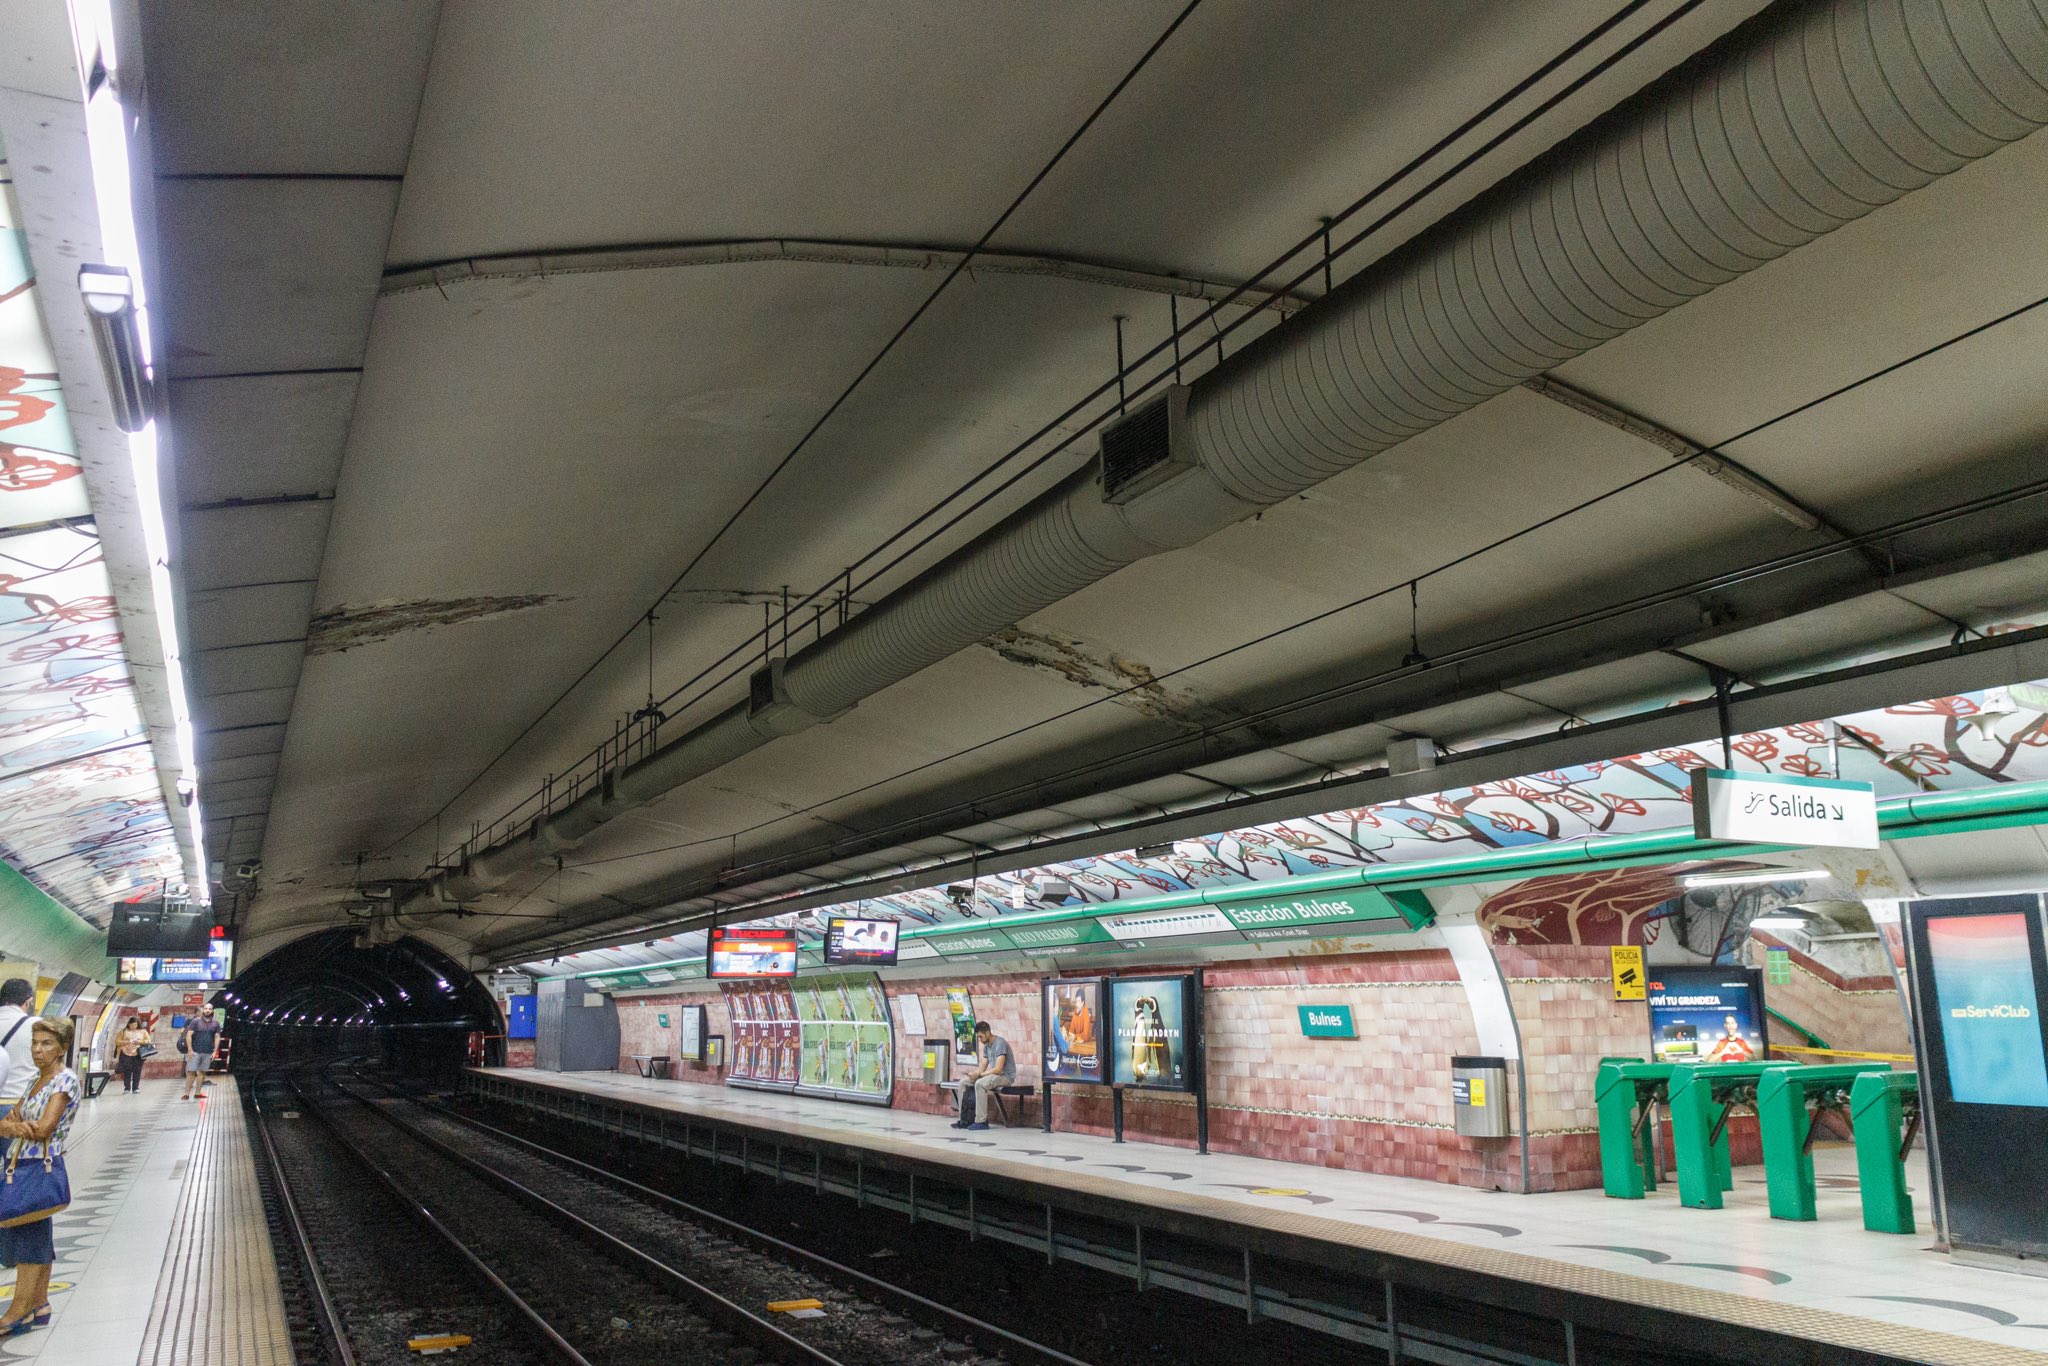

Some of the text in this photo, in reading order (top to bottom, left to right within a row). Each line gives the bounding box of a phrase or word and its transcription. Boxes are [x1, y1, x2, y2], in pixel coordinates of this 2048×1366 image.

[1769, 794, 1827, 820] Salida
[1228, 899, 1355, 924] Estación Bulnes
[1011, 926, 1079, 943] ALTO PALERMO
[964, 937, 996, 950] Bulnes
[1649, 981, 1666, 990] TCL
[1666, 996, 1677, 1005] TU
[1678, 996, 1721, 1006] GRANDEZA
[1966, 1004, 2031, 1018] ServiClub
[1308, 1011, 1343, 1027] Bulnes
[1118, 1028, 1180, 1038] PLANA MADRYN
